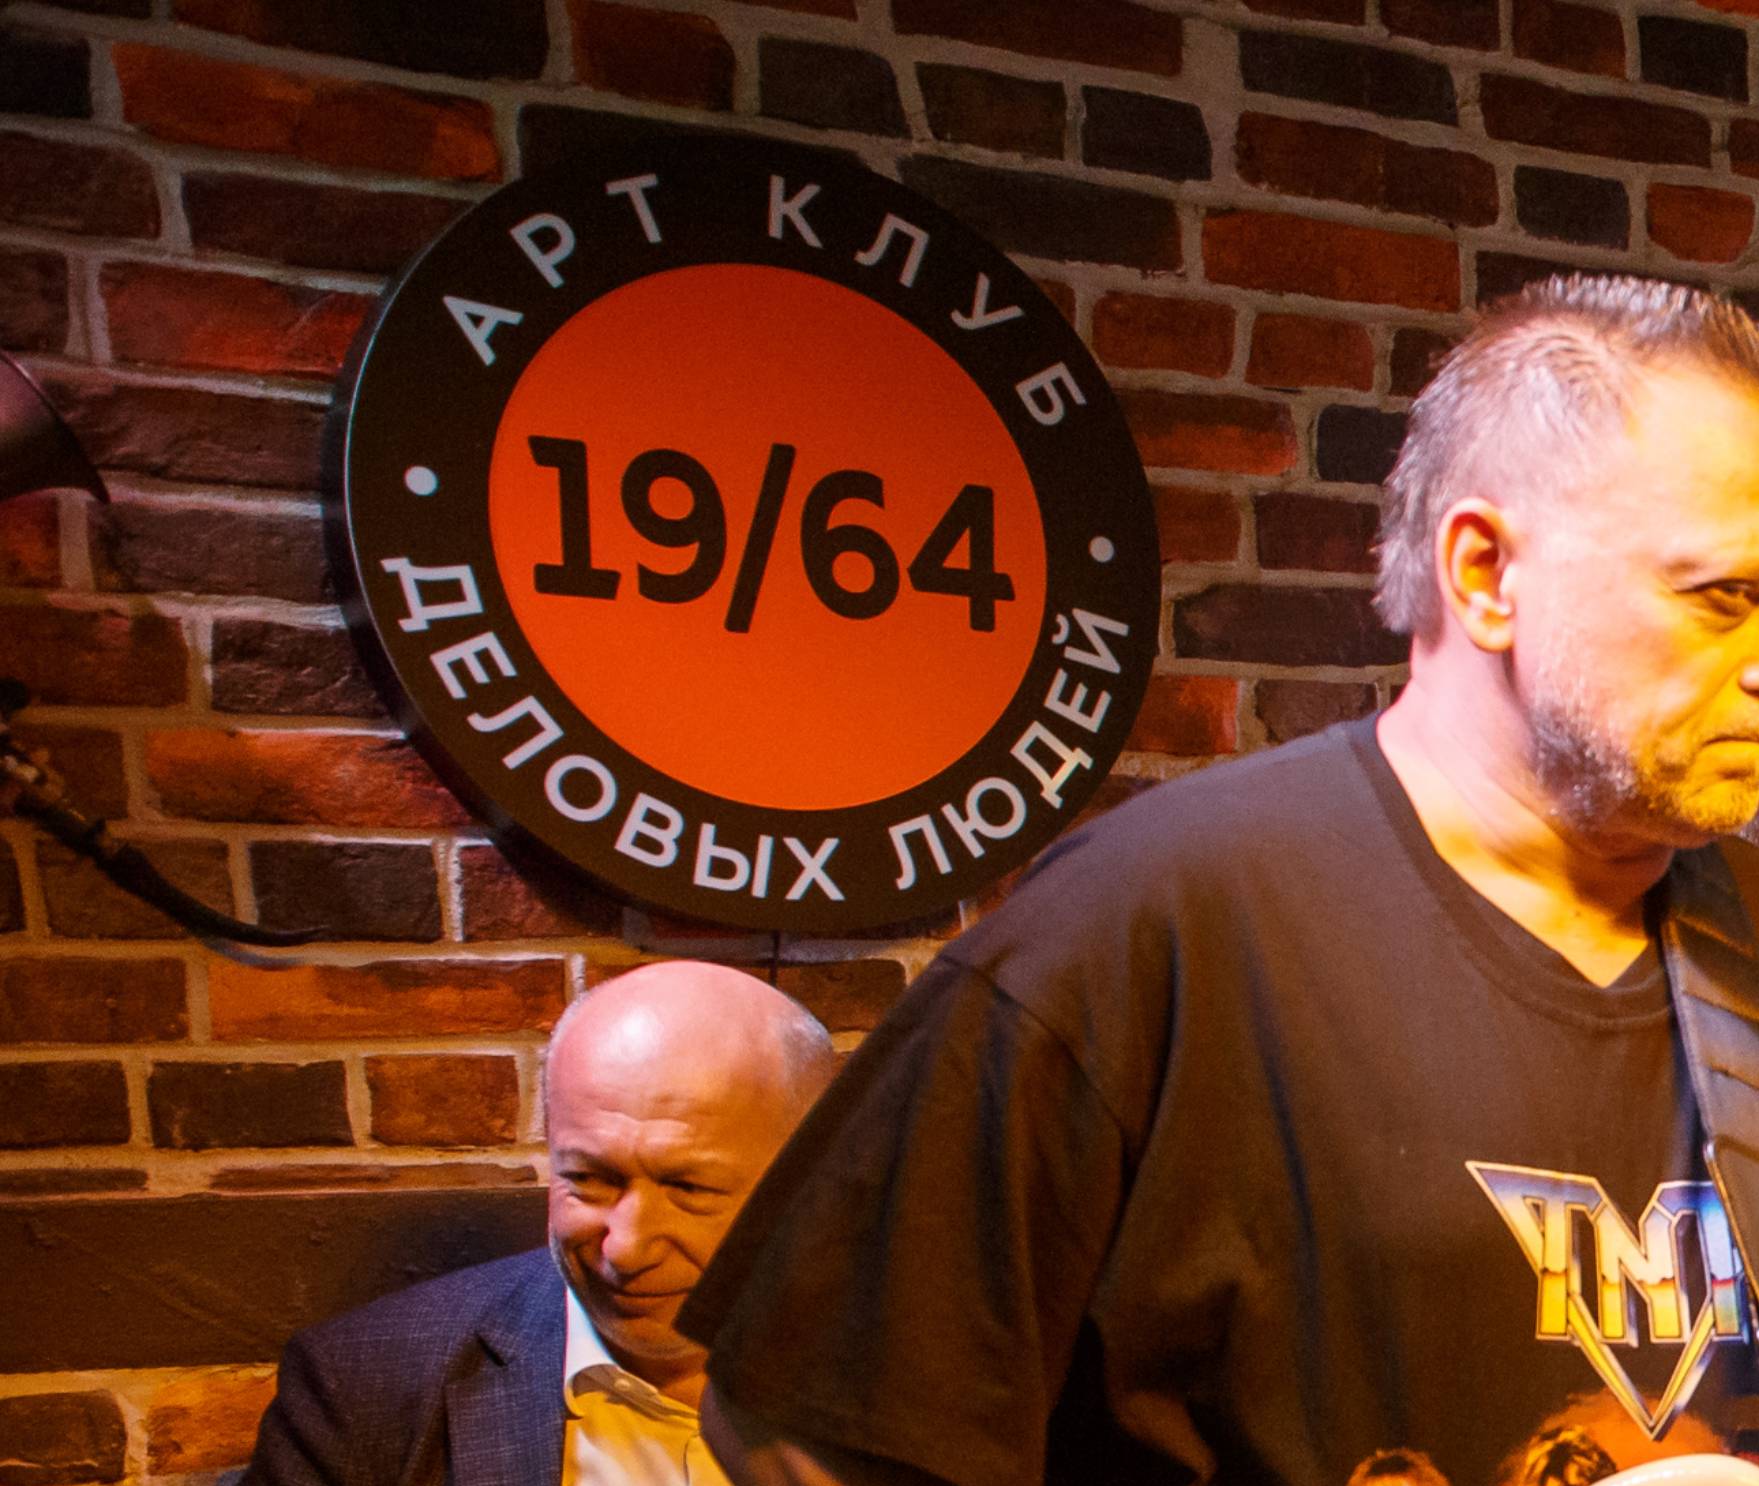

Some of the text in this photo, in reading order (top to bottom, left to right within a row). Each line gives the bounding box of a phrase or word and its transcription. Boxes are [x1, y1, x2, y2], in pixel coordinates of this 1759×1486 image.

[443, 174, 1087, 427] АРТ КЛУБ
[526, 434, 1017, 635] 19/64
[381, 556, 1130, 903] ДЕЛОВЫХ ЛЮДЕЙ
